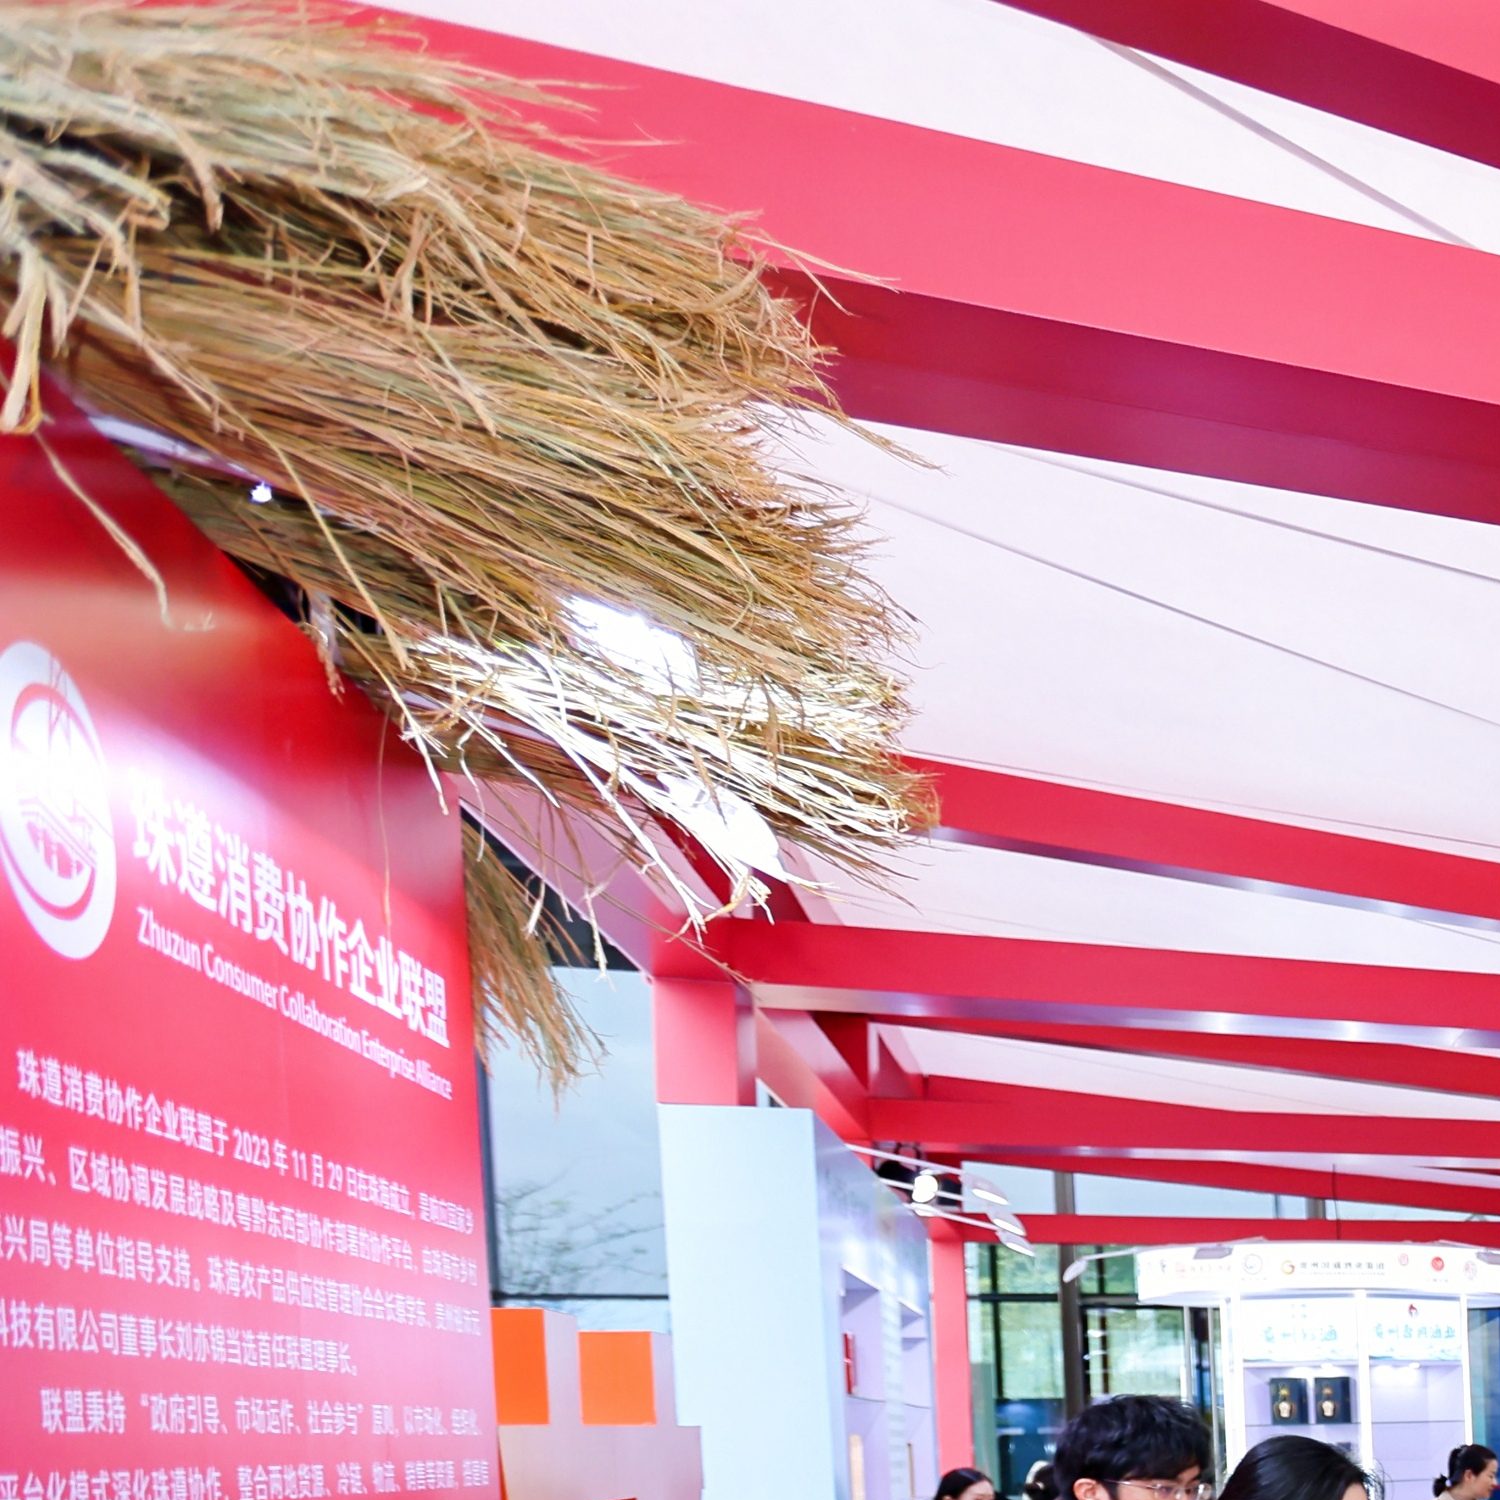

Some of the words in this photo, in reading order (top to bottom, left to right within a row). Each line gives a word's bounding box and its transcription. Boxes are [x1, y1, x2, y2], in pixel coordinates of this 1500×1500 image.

[129, 784, 450, 1049] 珠遵消费协作企业联盟
[136, 905, 202, 974] Zhuzun
[202, 943, 278, 1010] Consumer
[278, 984, 362, 1053] Collaboration
